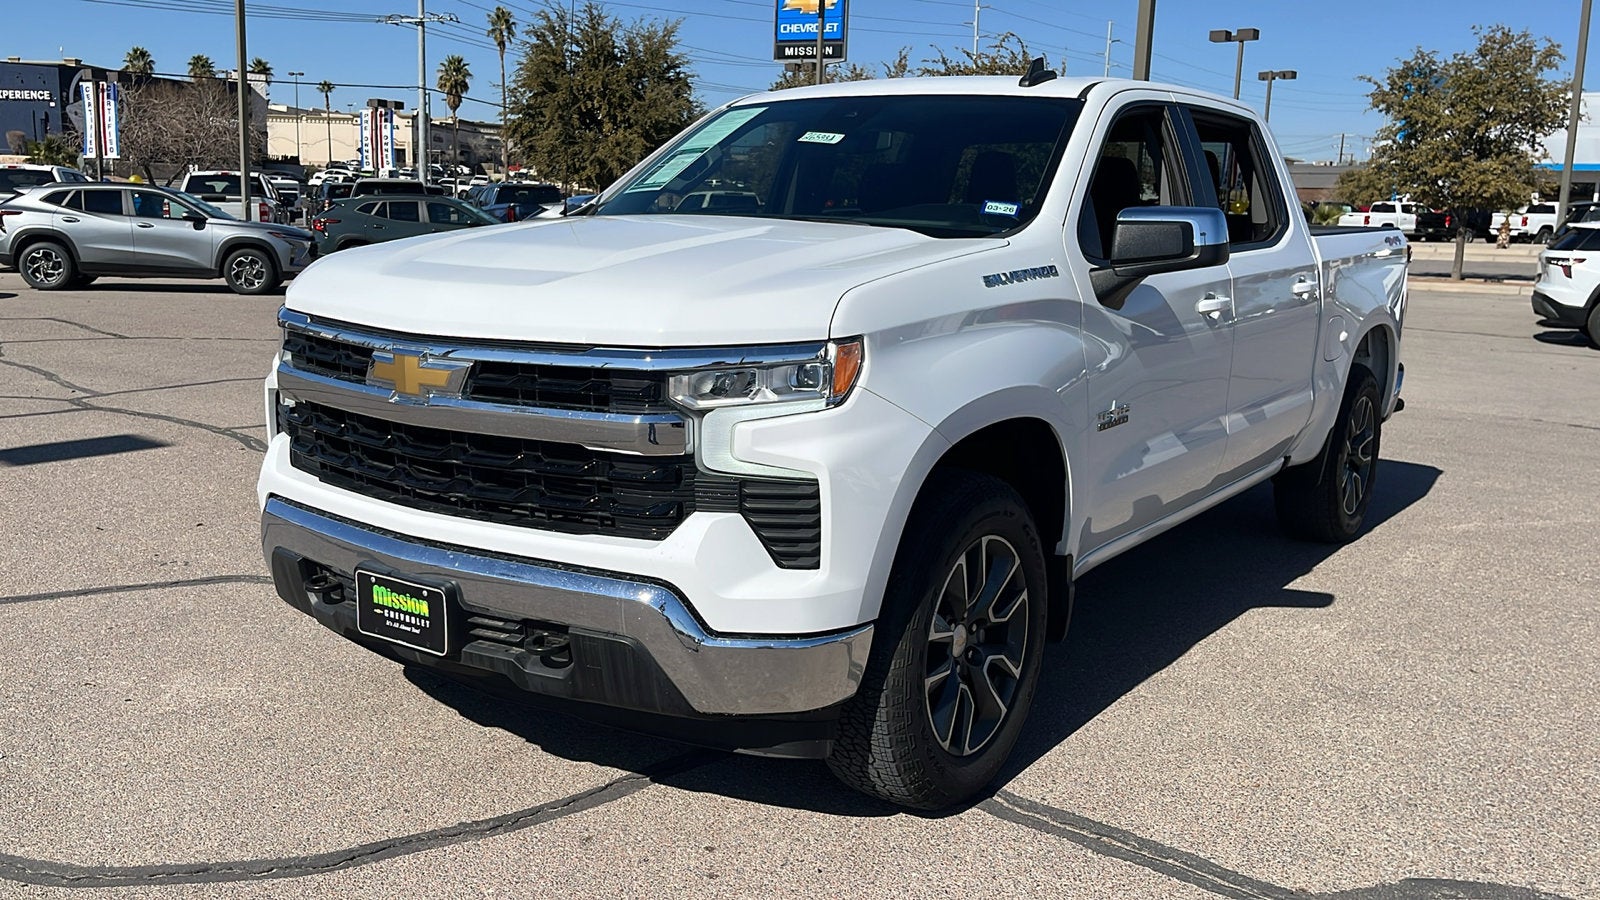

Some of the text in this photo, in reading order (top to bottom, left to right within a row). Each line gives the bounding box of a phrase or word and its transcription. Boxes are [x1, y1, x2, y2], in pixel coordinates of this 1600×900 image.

[784, 46, 833, 56] MISSIN
[983, 264, 1059, 288] SILVERADO
[372, 584, 430, 618] Mission
[384, 609, 430, 628] CHEVROLET
